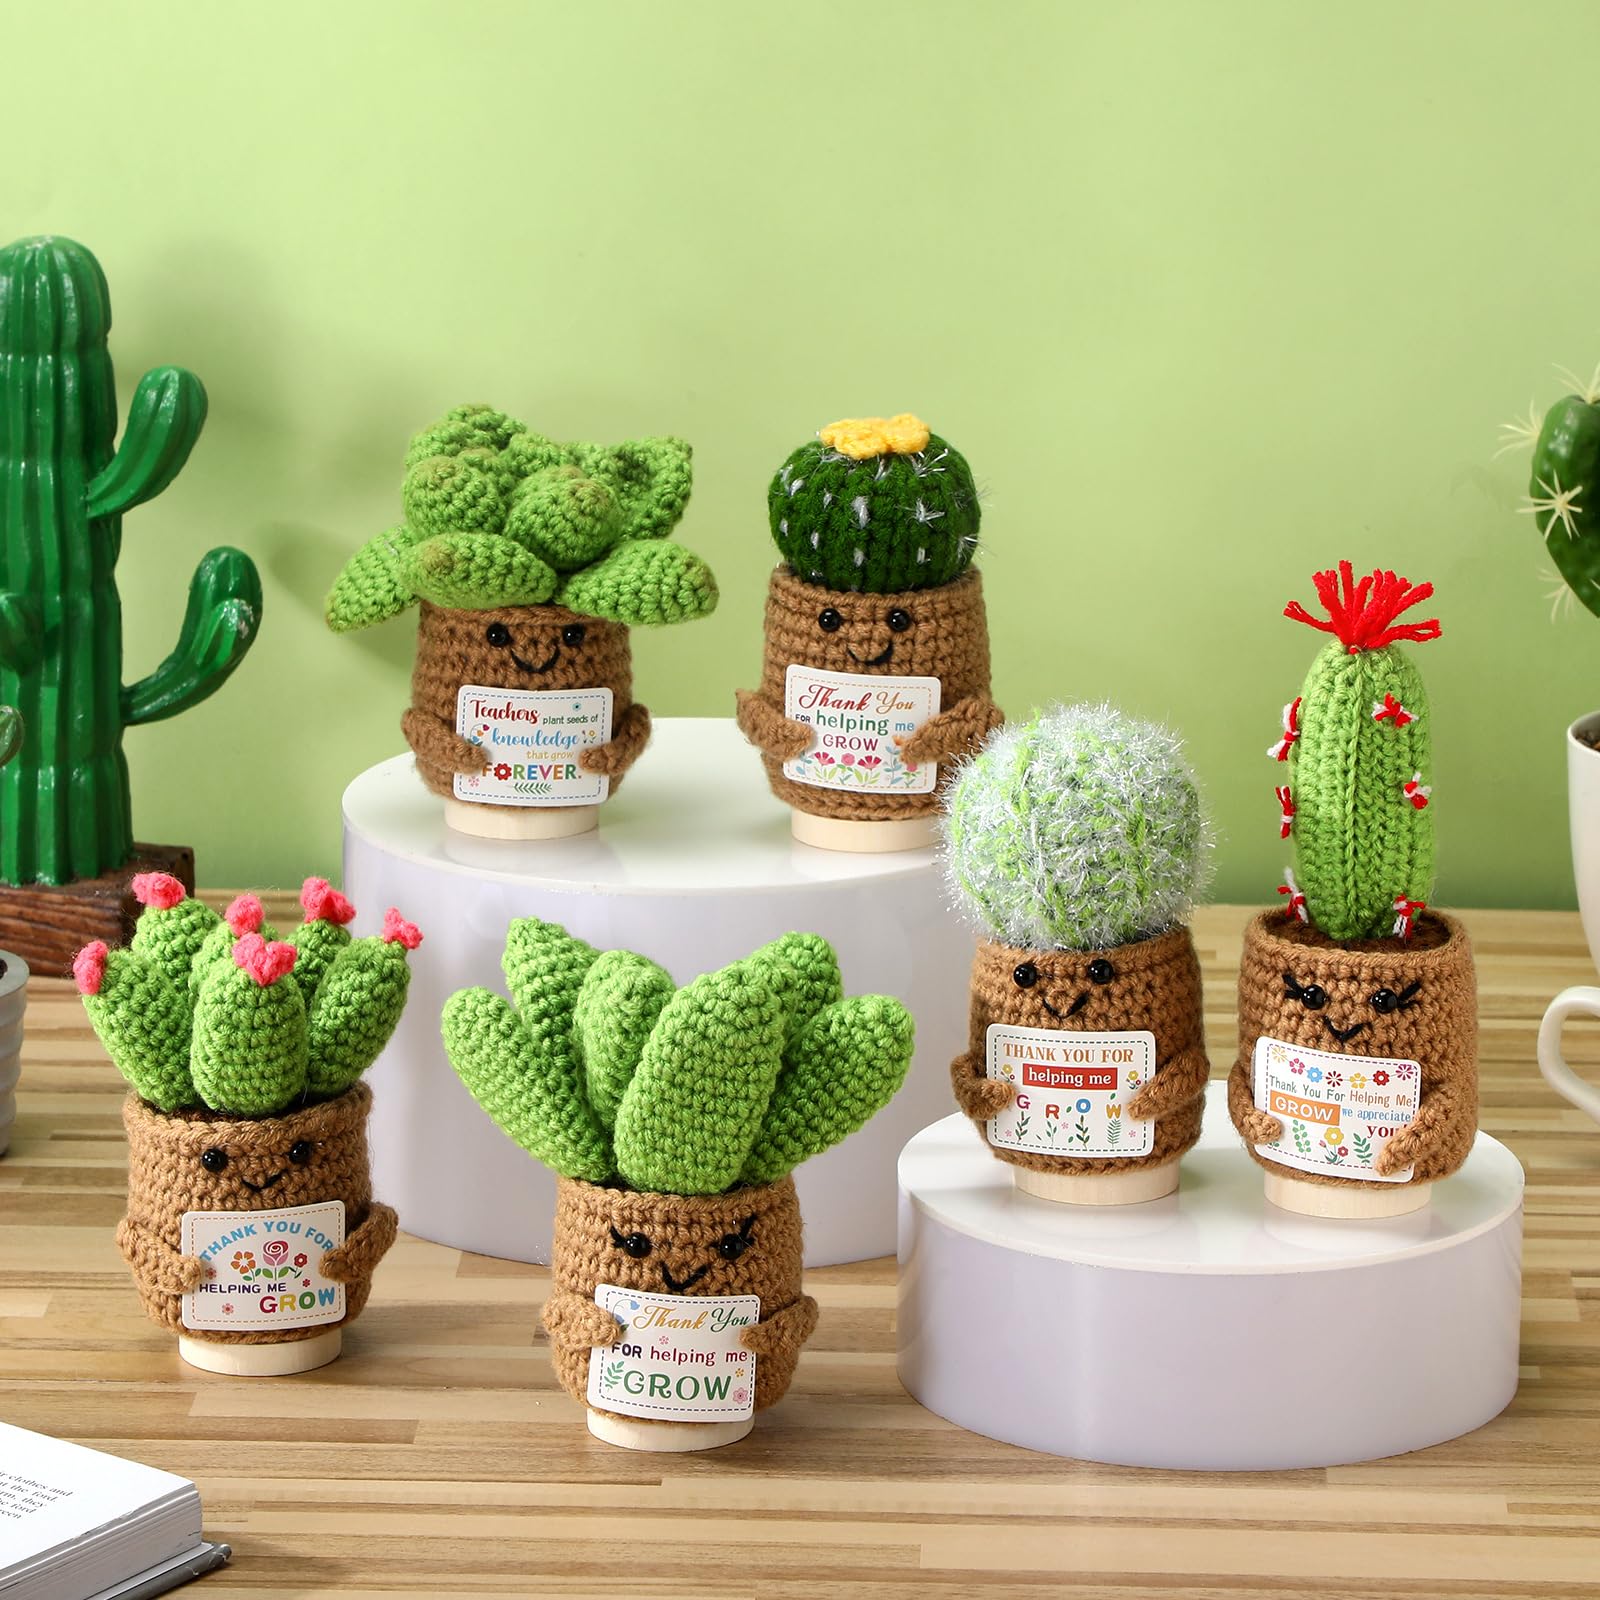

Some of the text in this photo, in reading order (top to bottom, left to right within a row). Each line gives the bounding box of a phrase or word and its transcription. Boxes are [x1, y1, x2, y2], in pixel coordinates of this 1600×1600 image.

[799, 684, 915, 714] Thank You
[470, 699, 599, 725] Teachers plant seeds of
[796, 710, 914, 736] FOR helping me
[491, 728, 580, 749] knowledge
[823, 734, 878, 751] GROW
[527, 751, 574, 761] that grow
[1003, 1043, 1133, 1062] THANK YOU FOR
[1029, 1067, 1111, 1087] helping me
[1269, 1075, 1412, 1107] Thank You For Helping Me
[1275, 1097, 1410, 1122] GROW we appreciate
[200, 1221, 334, 1262] THANK YOU FOR
[200, 1283, 286, 1294] HELPING ME
[260, 1287, 335, 1313] GROW
[632, 1305, 750, 1332] Thank You
[612, 1342, 747, 1366] FOR helping me
[623, 1371, 731, 1400] GROW
[49, 1488, 73, 1497] and
